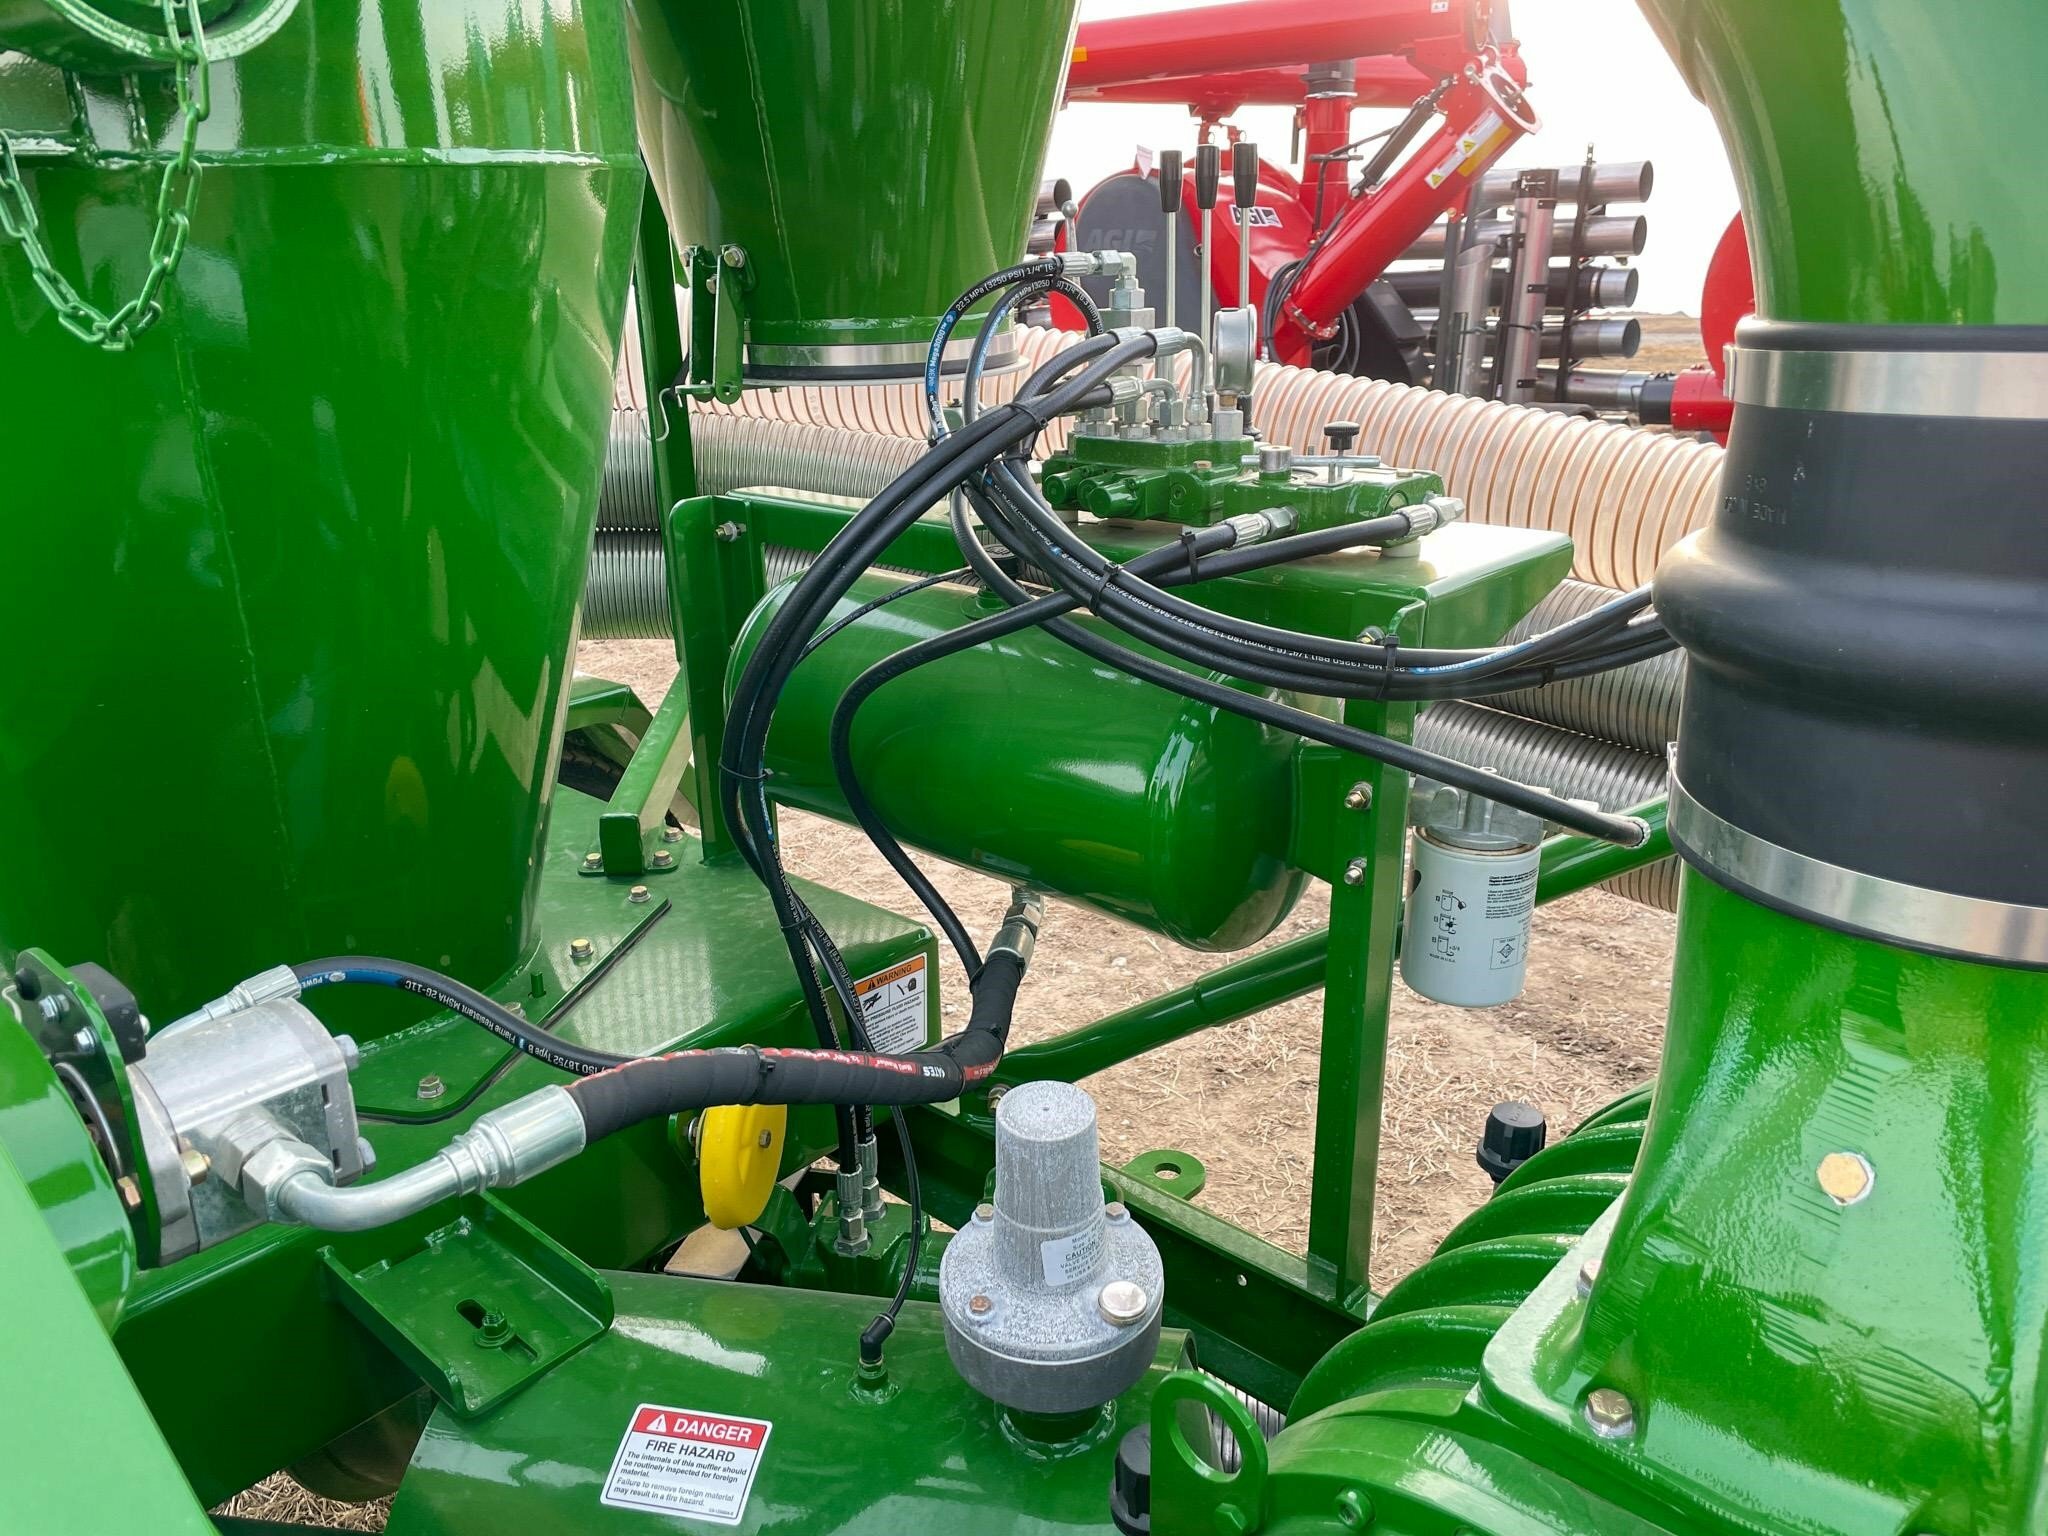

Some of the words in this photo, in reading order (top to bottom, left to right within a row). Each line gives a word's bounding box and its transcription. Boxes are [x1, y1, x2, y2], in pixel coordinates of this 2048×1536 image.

[1234, 206, 1265, 225] AGI
[1087, 229, 1134, 251] AGI
[955, 297, 971, 311] 22.5
[969, 287, 984, 299] MPa
[876, 964, 912, 986] WARNING
[405, 980, 438, 999] 2G-11C
[439, 993, 461, 1011] MSHA
[461, 1004, 495, 1030] Resistant
[494, 1025, 516, 1044] Flame
[528, 1044, 534, 1054] B
[535, 1047, 551, 1060] Type
[553, 1055, 580, 1072] 18752
[673, 1418, 752, 1443] DANGER
[645, 1440, 677, 1454] FIRE
[679, 1443, 735, 1462] HAZARD
[620, 1467, 650, 1478] material.
[627, 1451, 640, 1459] The
[641, 1453, 671, 1464] internals
[672, 1457, 681, 1466] of
[681, 1459, 694, 1468] this
[696, 1461, 721, 1471] muffler
[722, 1465, 747, 1476] should
[633, 1461, 665, 1473] routinely
[665, 1464, 700, 1477] inspected
[712, 1473, 738, 1484] foreign
[614, 1486, 629, 1495] may
[630, 1488, 651, 1497] result
[651, 1490, 659, 1498] in
[665, 1492, 678, 1501] fire
[678, 1496, 705, 1507] hazard.
[617, 1477, 641, 1487] Failure
[642, 1480, 650, 1488] to
[651, 1484, 677, 1493] remove
[678, 1486, 704, 1498] foreign
[705, 1491, 734, 1502] material
